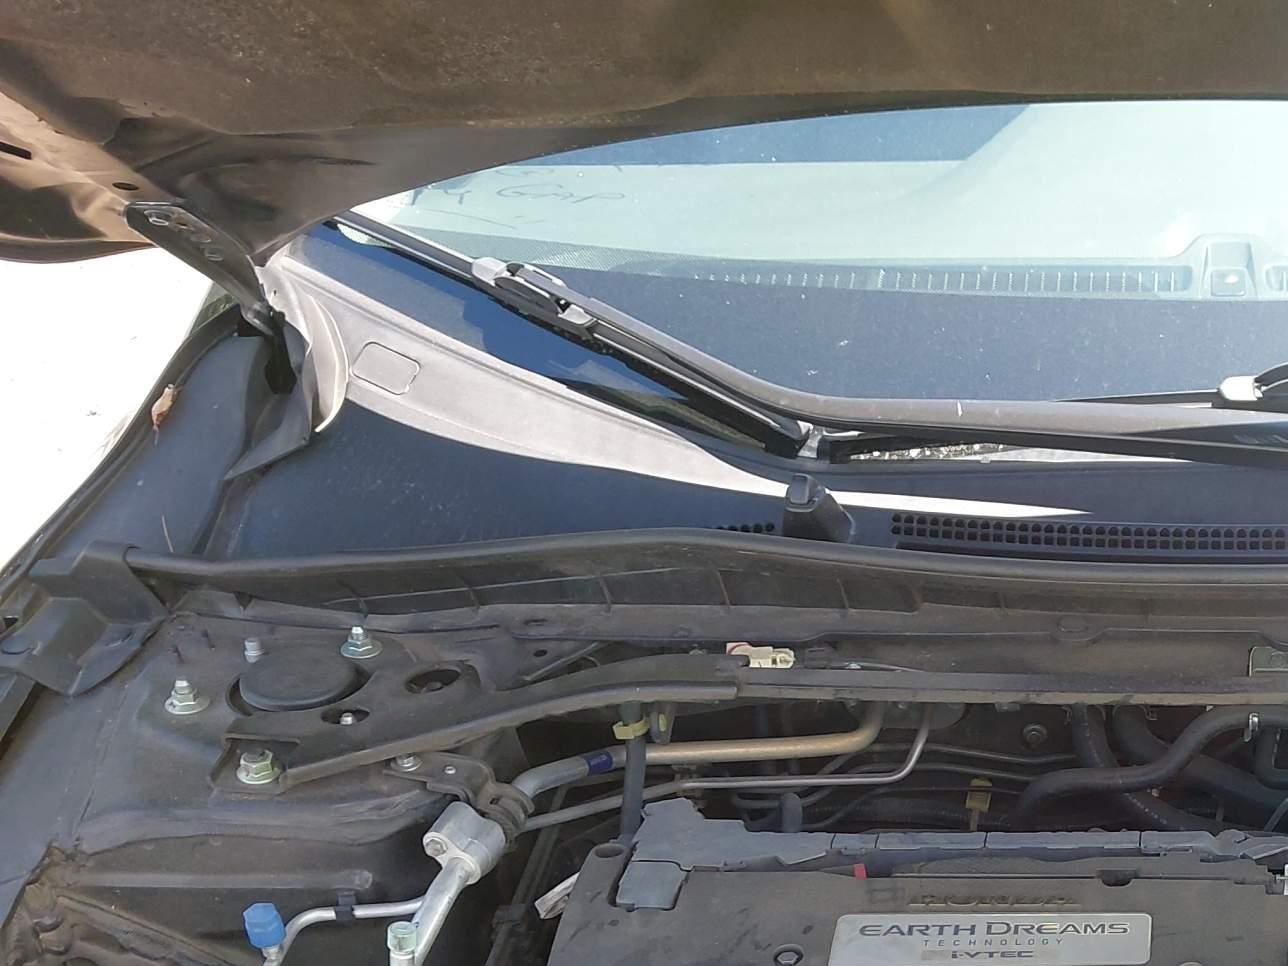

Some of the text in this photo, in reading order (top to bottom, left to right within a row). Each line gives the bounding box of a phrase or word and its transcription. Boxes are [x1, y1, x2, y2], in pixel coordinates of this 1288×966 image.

[859, 921, 1129, 937] EARTH DREAMS
[951, 951, 1034, 959] i-VTEC
